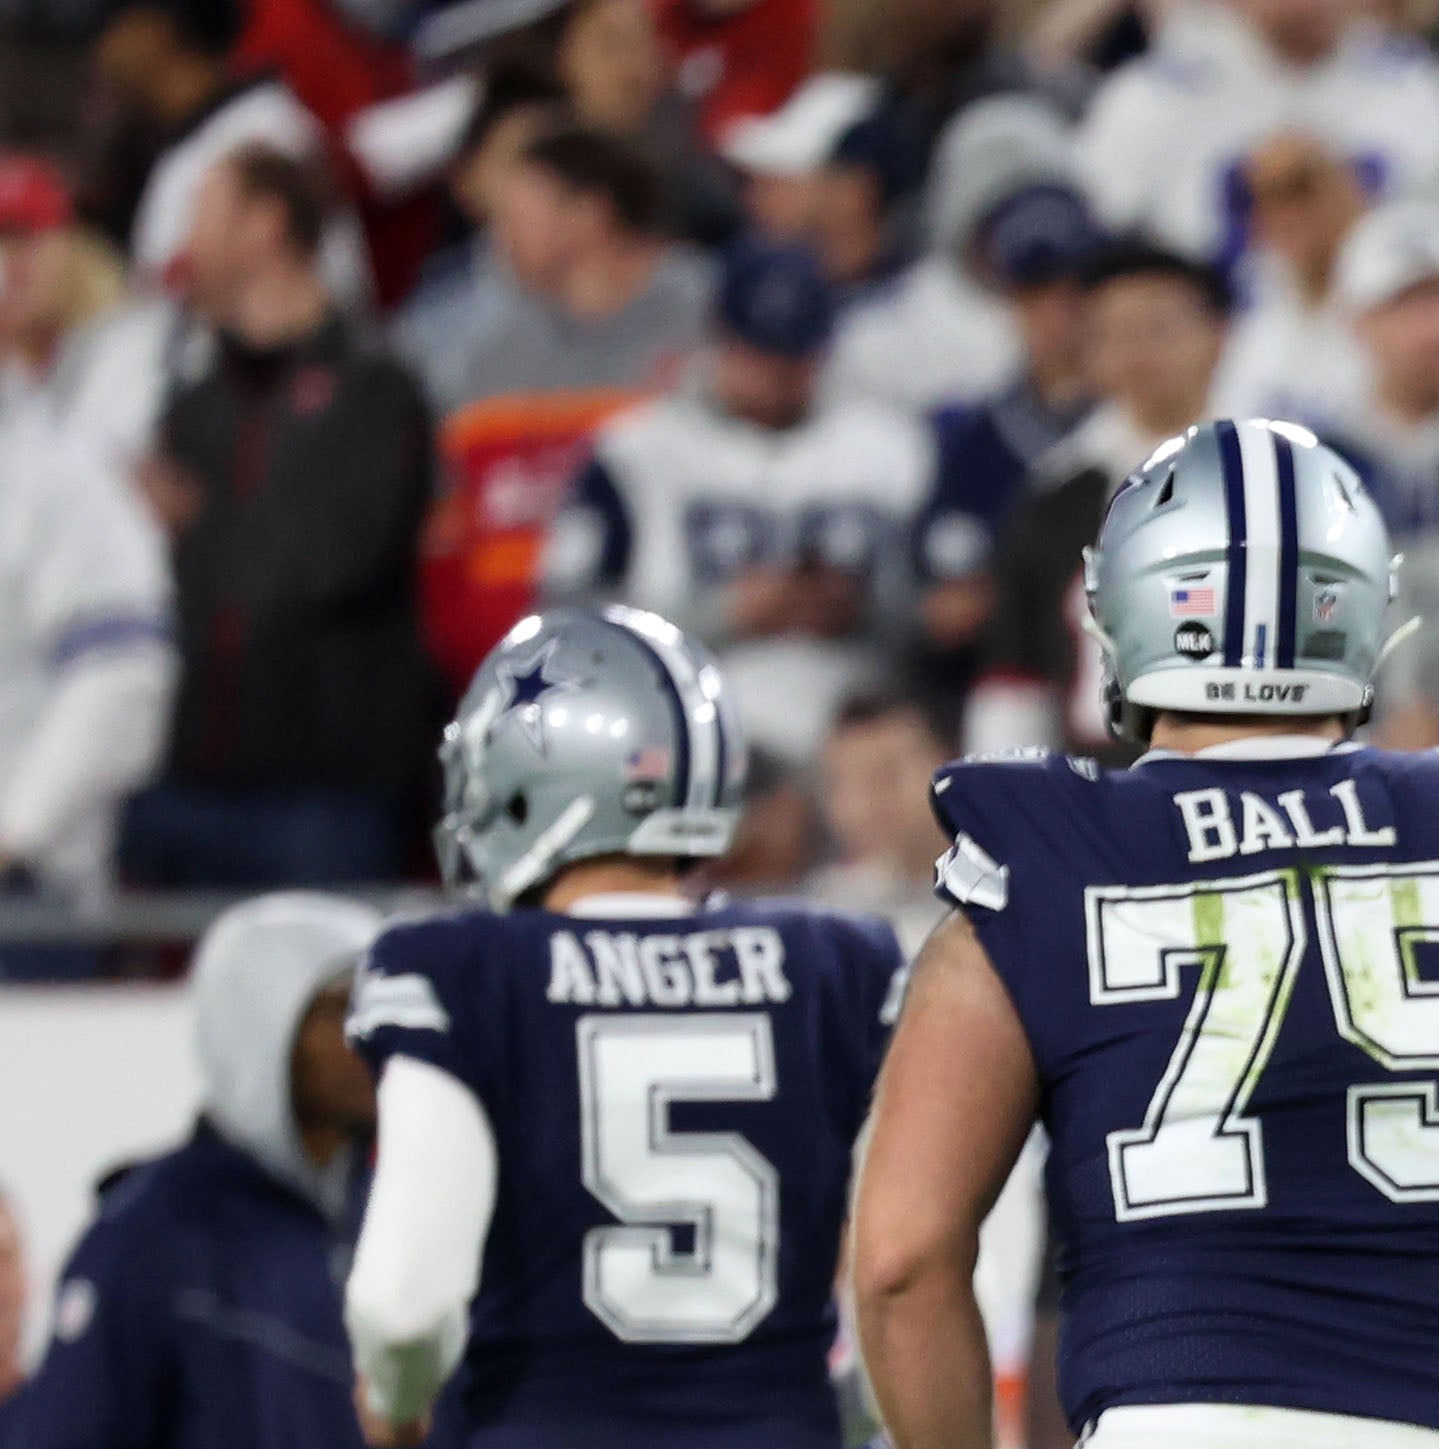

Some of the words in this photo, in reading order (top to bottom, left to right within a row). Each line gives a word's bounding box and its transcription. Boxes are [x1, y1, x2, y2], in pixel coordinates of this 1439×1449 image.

[1176, 632, 1211, 652] MLK
[1205, 682, 1235, 701] BE
[1244, 683, 1305, 702] LOVE
[1173, 780, 1397, 863] BALL
[546, 926, 791, 1006] ANGER
[576, 1012, 779, 1344] 5
